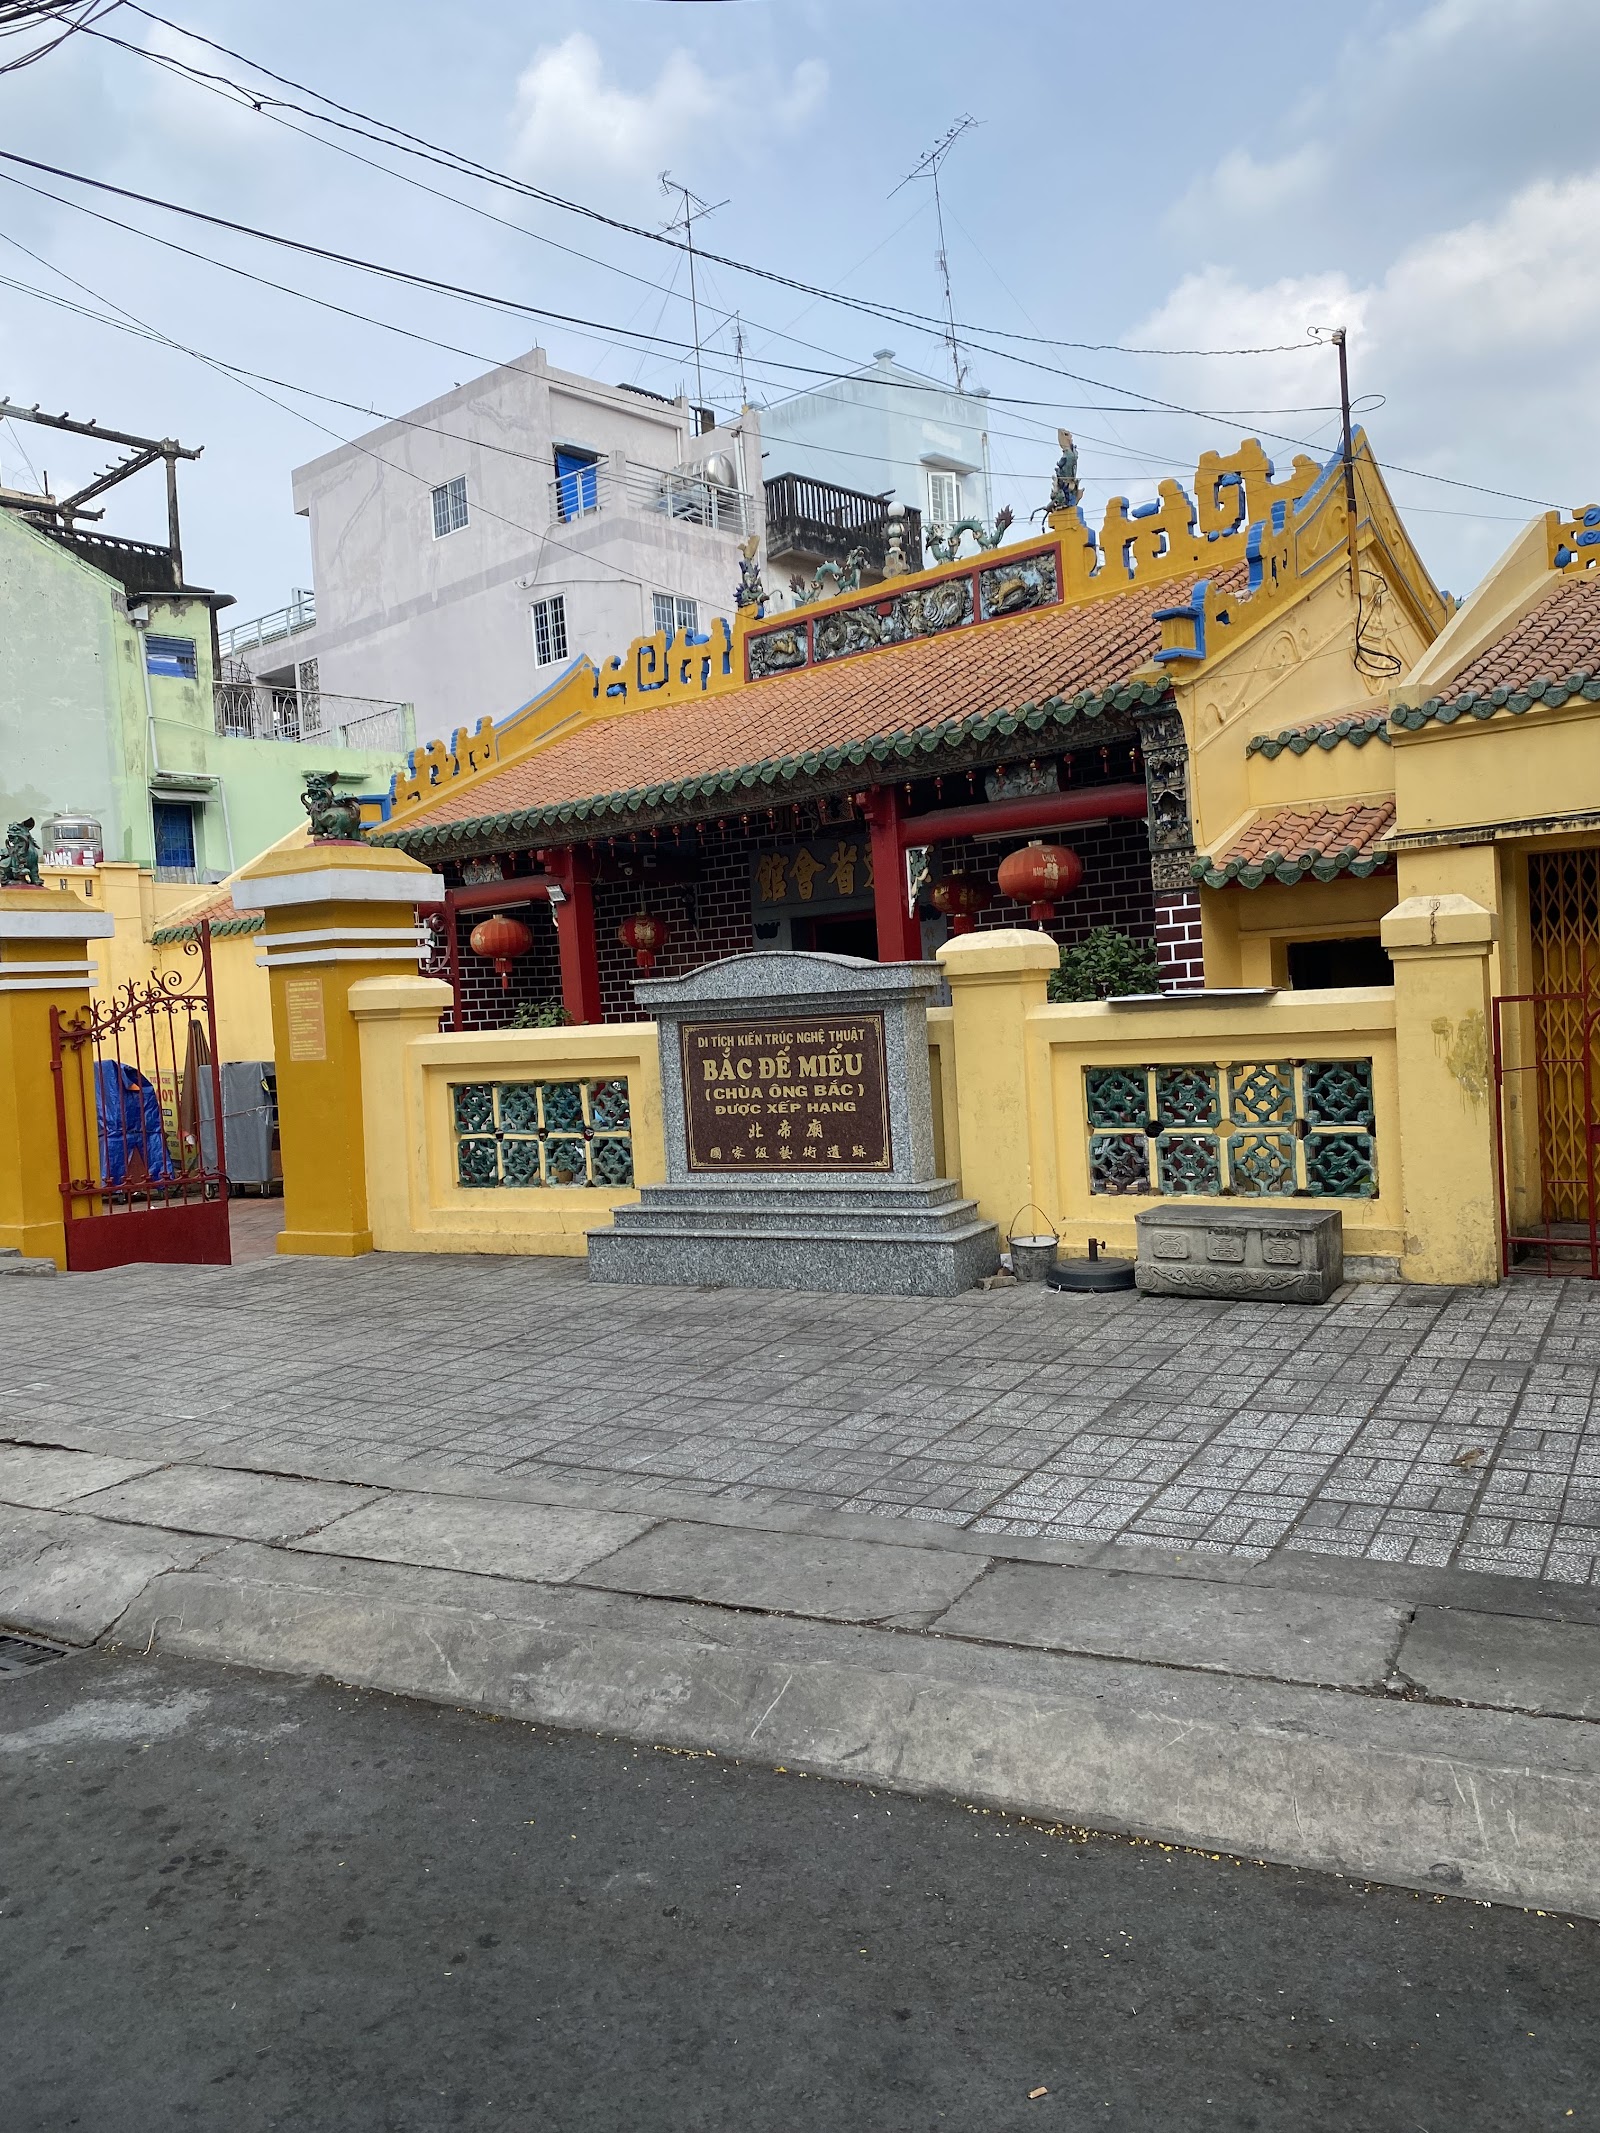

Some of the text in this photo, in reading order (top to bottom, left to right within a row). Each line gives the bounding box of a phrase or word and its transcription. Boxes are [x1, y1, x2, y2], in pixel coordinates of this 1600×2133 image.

[697, 1026, 865, 1048] DI TÍCH KIẾN TRÚC NGHỆ THUẬT
[702, 1042, 863, 1081] BẮC ĐẾ MIẾU
[768, 1083, 808, 1098] ÔNG
[715, 1099, 856, 1116] ĐƯỢC XẾP HẠNG
